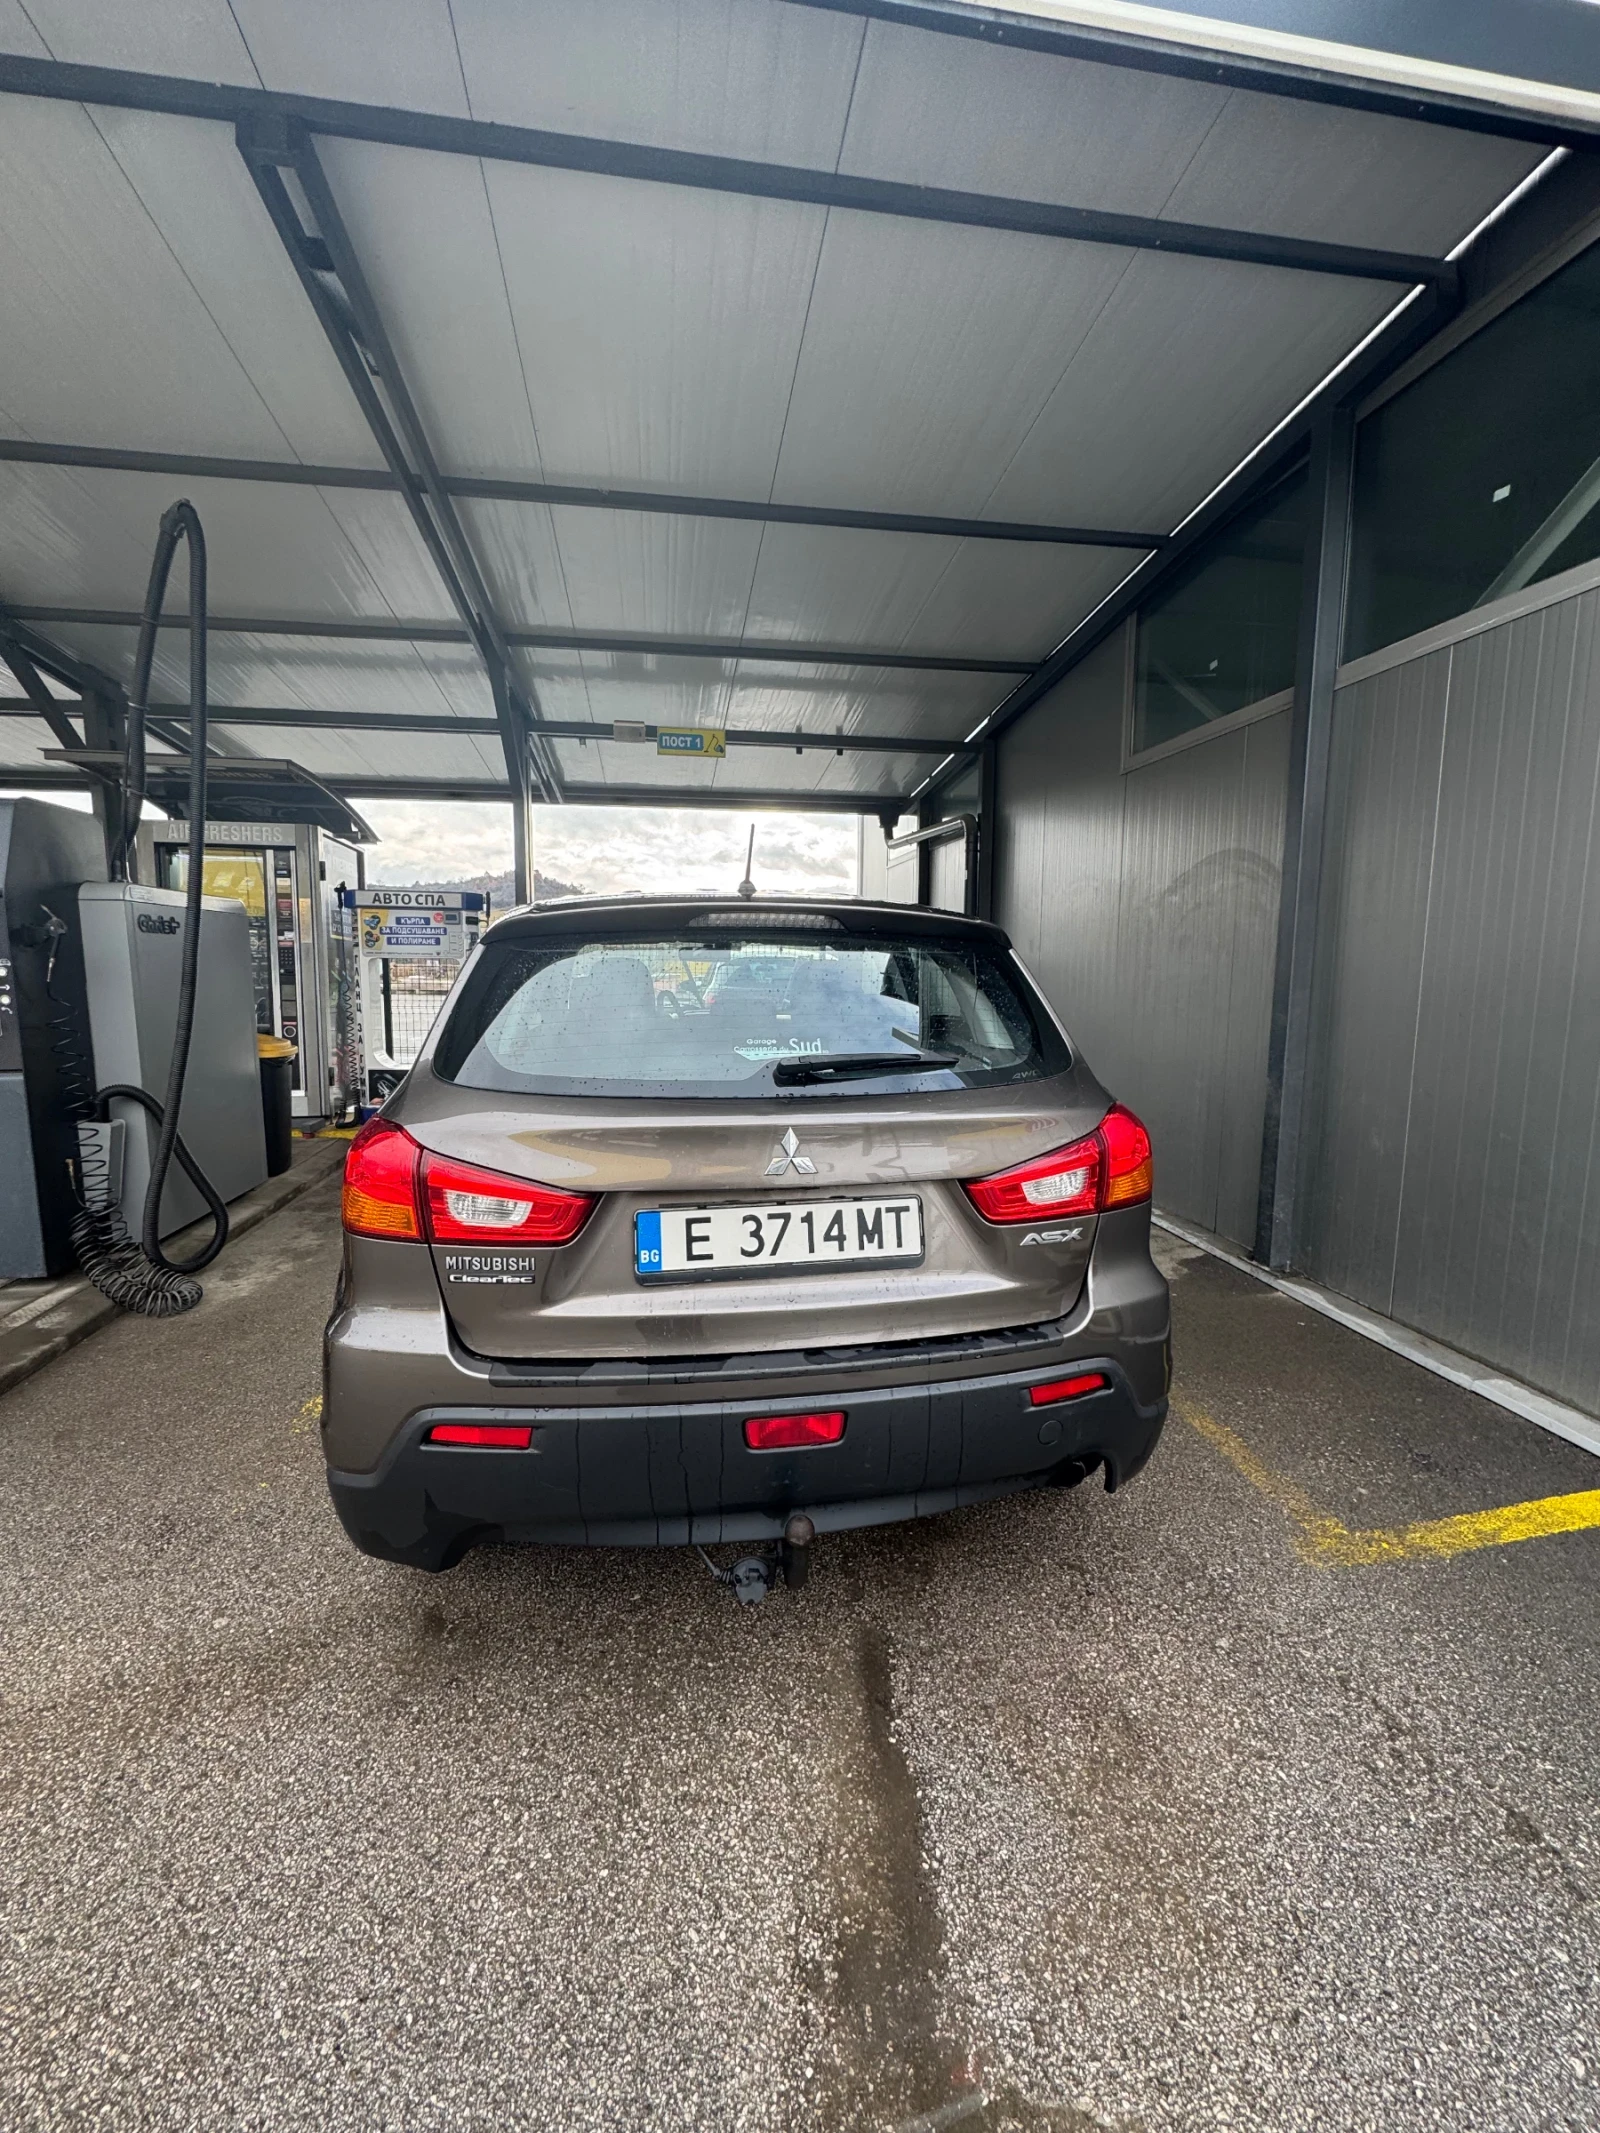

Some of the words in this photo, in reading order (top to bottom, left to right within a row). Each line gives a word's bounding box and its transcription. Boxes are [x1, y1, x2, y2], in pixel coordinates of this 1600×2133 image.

[662, 735, 692, 748] ПОСТ
[695, 738, 701, 748] 1
[372, 892, 412, 906] АВТО
[415, 893, 446, 907] СПА
[400, 917, 425, 926] КЪРПА
[381, 926, 391, 935] ЗА
[391, 937, 397, 945] И
[398, 937, 436, 946] ПОЛИРАНЕ
[746, 1038, 777, 1046] Garage
[789, 1038, 822, 1054] Sud
[685, 1216, 714, 1262] E
[1020, 1227, 1084, 1247] ASX
[445, 1256, 535, 1271] MITSUBISHI
[640, 1250, 660, 1264] BG
[449, 1274, 533, 1284] ClearTec
